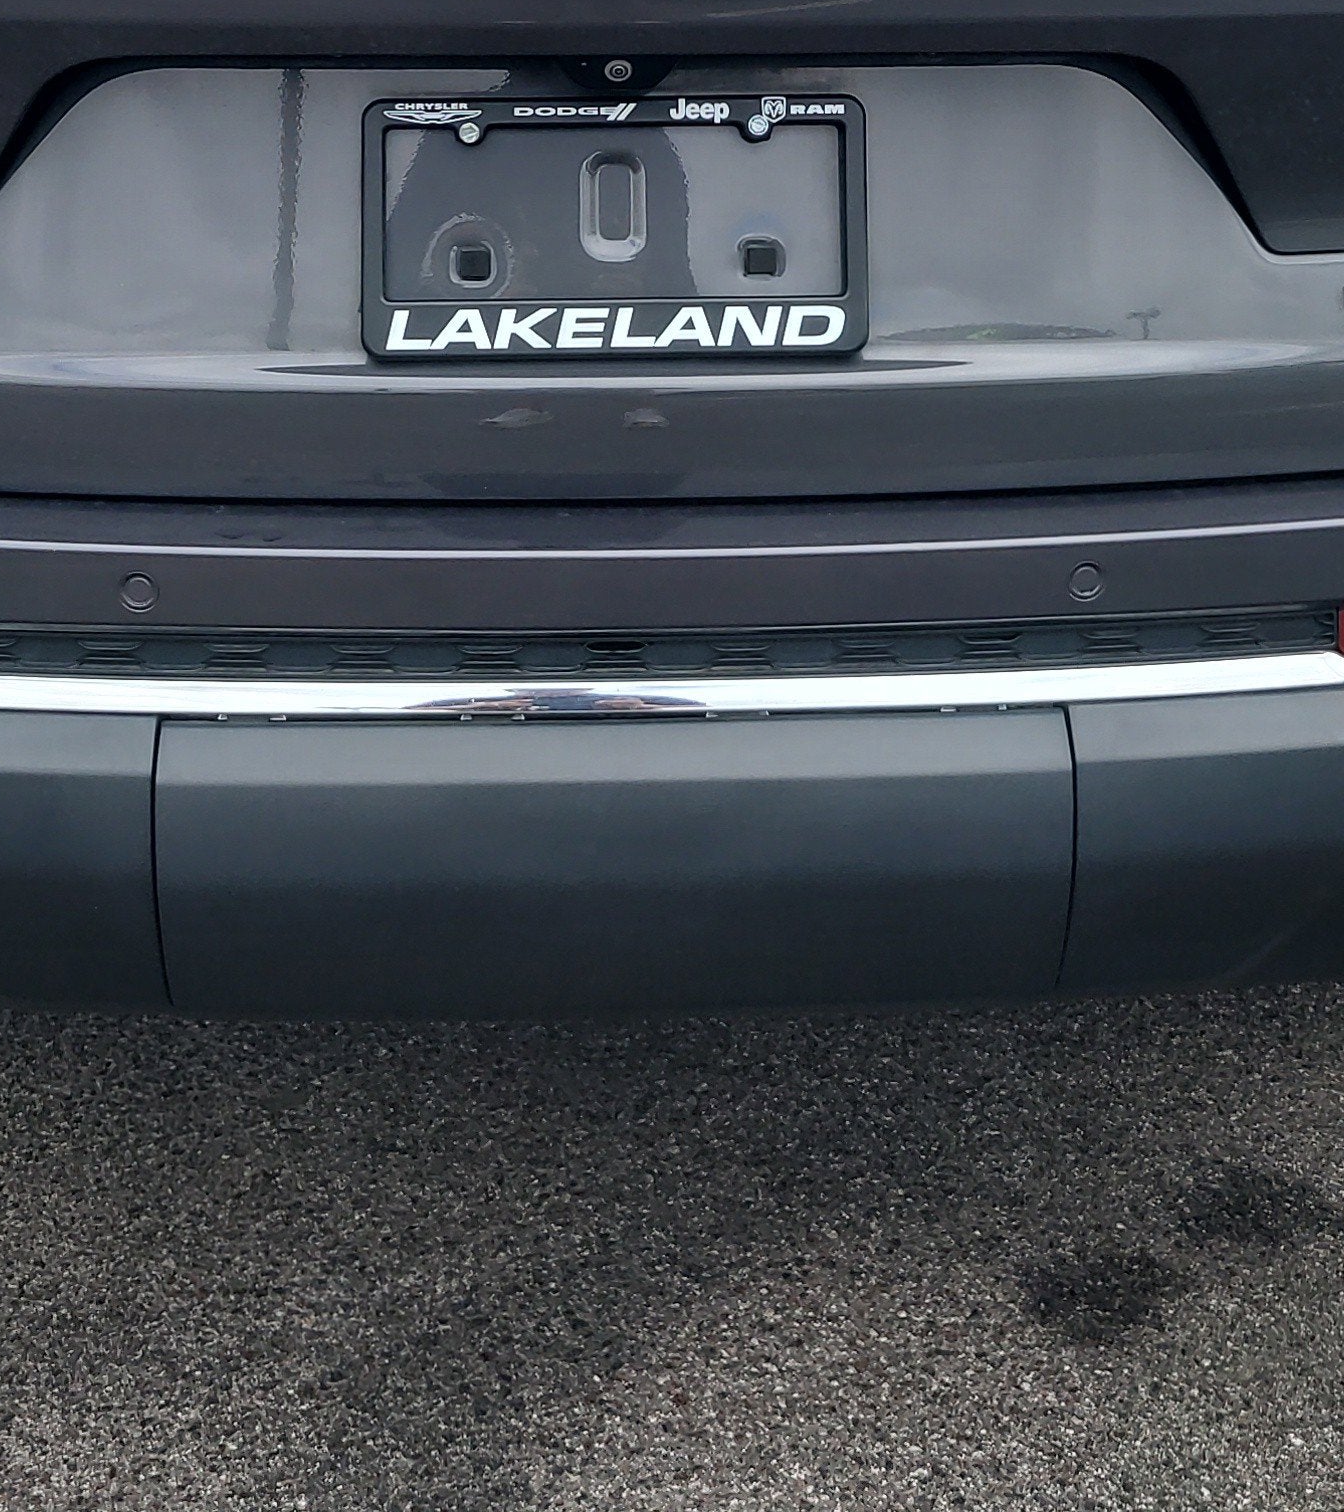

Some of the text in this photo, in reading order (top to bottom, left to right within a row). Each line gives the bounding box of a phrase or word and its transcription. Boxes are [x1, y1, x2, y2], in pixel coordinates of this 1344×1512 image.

[394, 102, 469, 110] CHRYSLER
[513, 106, 617, 117] DODGE
[669, 98, 730, 123] Jeep
[789, 103, 845, 115] RAM
[385, 304, 846, 351] LAKELAND
